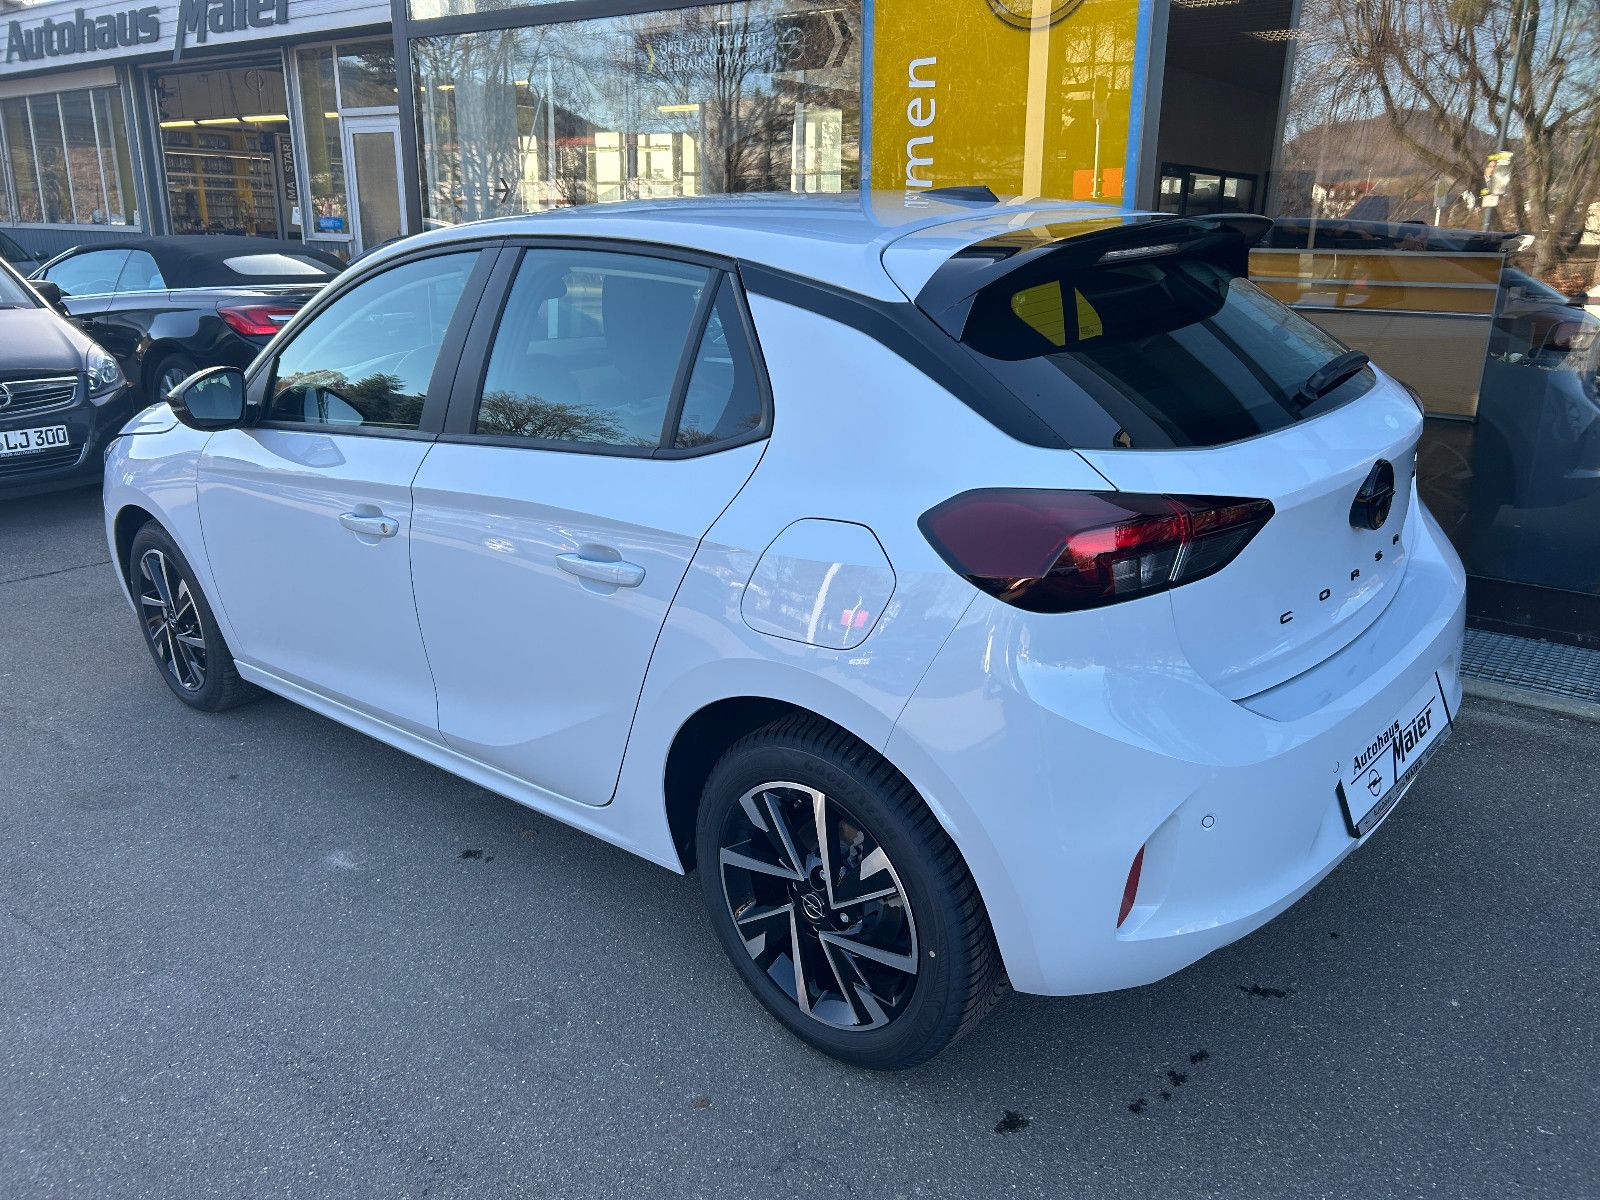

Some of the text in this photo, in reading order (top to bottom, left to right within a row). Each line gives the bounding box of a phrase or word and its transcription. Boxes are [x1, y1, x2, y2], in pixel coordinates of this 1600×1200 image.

[7, 0, 288, 63] Autohaus Maier
[659, 38, 684, 54] OPEL
[904, 56, 937, 189] men
[4, 428, 67, 450] LJ 300
[1279, 533, 1400, 625] CORSA
[1353, 719, 1401, 776] Autohaus
[1391, 707, 1432, 780] Maier
